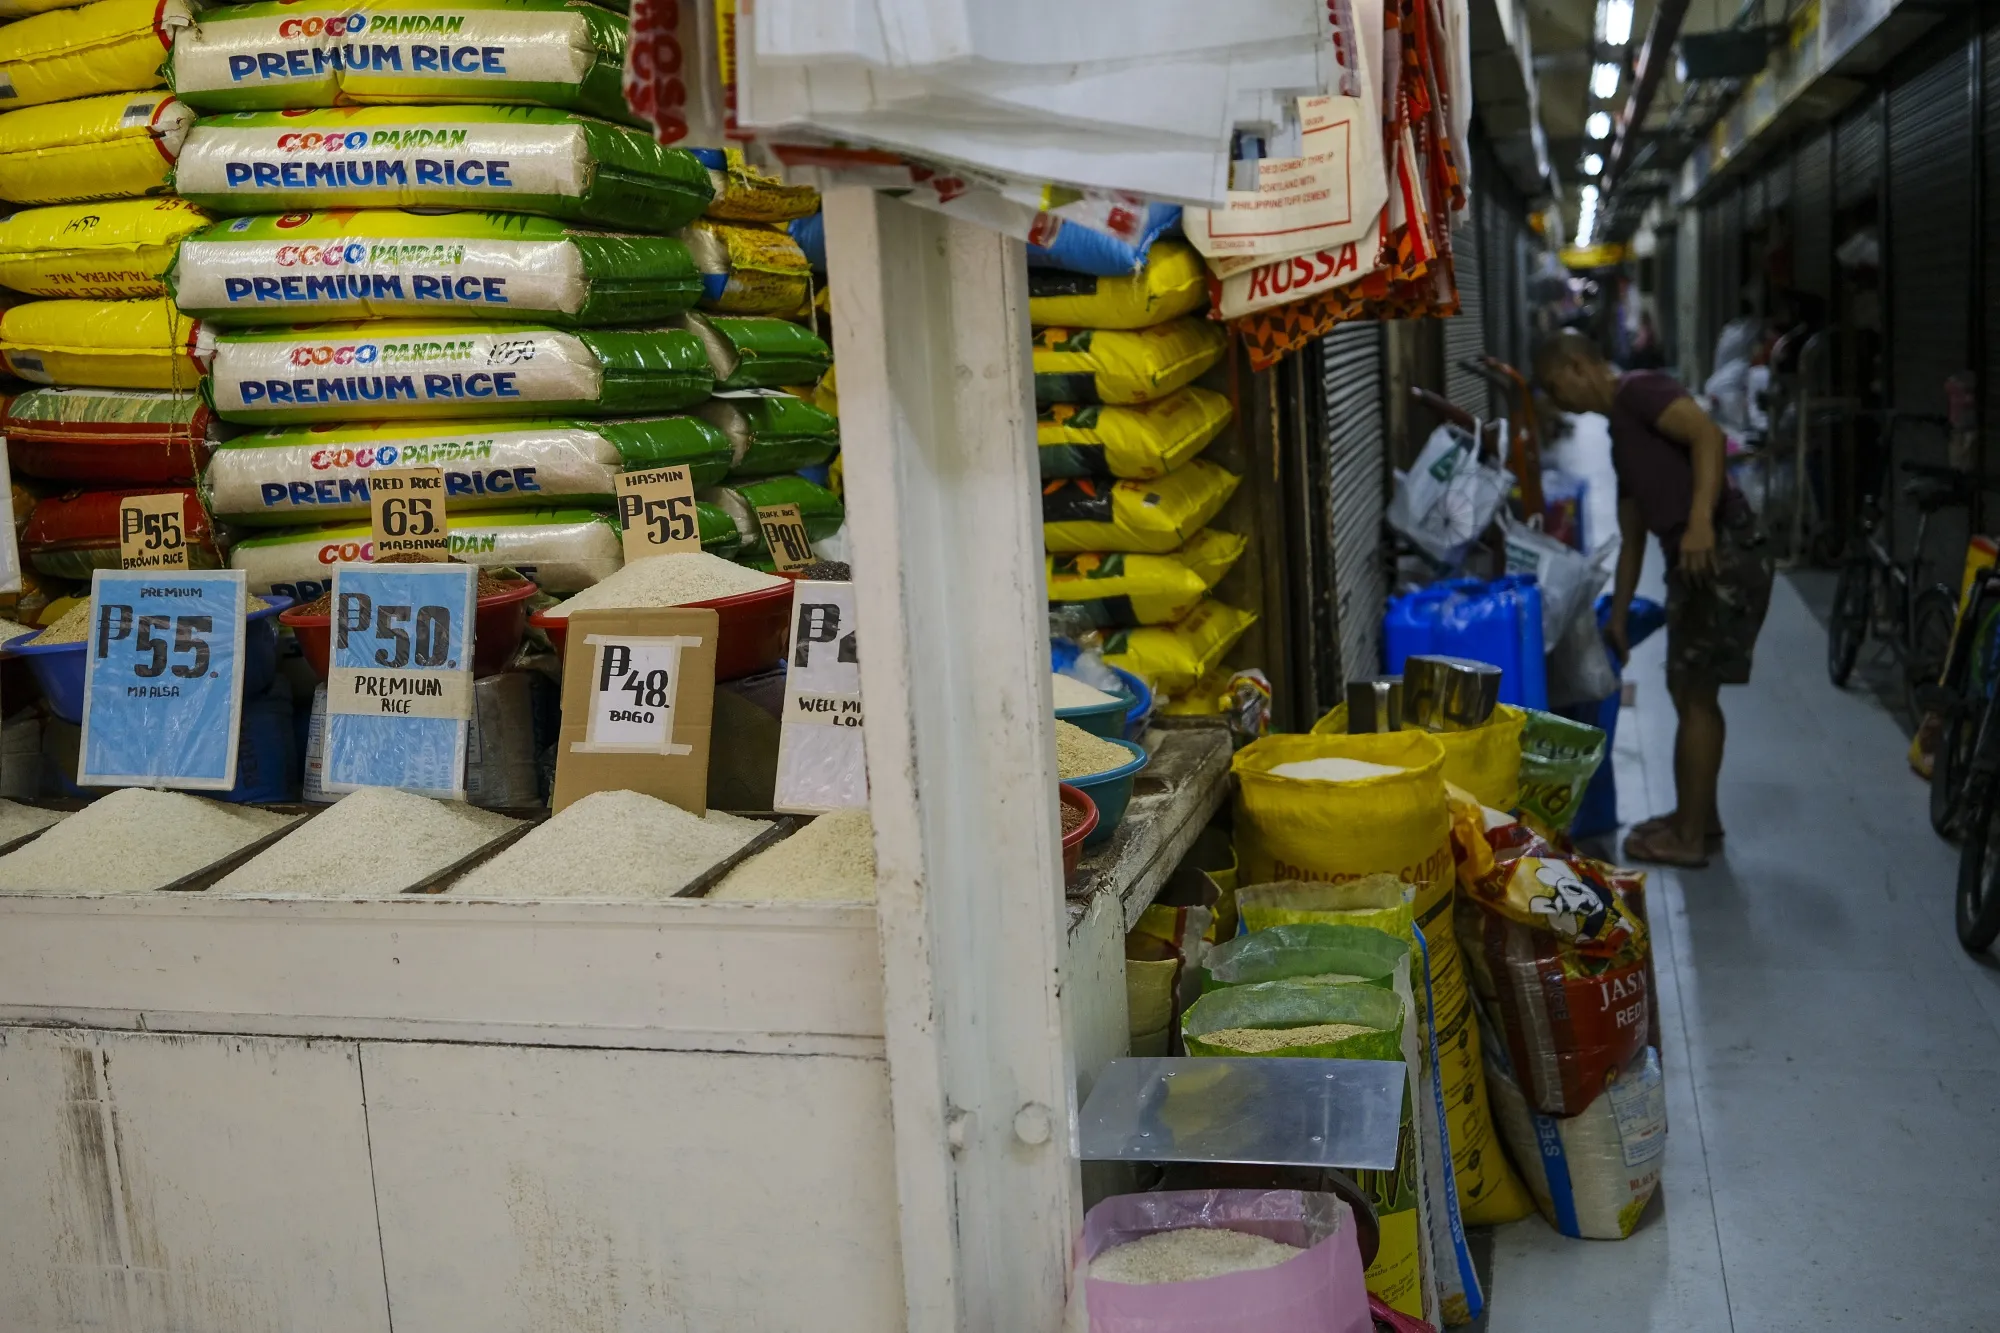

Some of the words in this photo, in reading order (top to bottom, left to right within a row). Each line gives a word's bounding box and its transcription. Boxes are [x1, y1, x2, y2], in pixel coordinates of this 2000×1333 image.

[278, 13, 366, 39] COCO
[369, 15, 465, 36] PANDAN
[411, 46, 507, 75] RICE
[277, 130, 368, 153] COCO
[371, 128, 468, 150] PANDAN
[224, 158, 408, 190] PREMIUM
[416, 158, 513, 188] RICE
[275, 243, 367, 267] COCO
[369, 243, 464, 266] PANDAN
[1247, 241, 1358, 301] ROSSA
[224, 274, 405, 302] PREMIUM
[412, 275, 509, 303] RICE
[290, 345, 378, 366] COCO
[381, 340, 476, 363] PANDAN
[239, 374, 417, 405] PREMIUM
[423, 371, 521, 399] RICE
[310, 446, 399, 471] COCO
[401, 439, 494, 465] PANDAN
[261, 479, 371, 507] PREM
[444, 467, 541, 494] RICE
[372, 477, 406, 492] RED
[409, 475, 443, 491] RICE
[625, 471, 684, 488] HASMIN
[317, 541, 374, 565] COC
[378, 538, 449, 552] MABANGO
[122, 552, 160, 570] BROWN
[162, 551, 184, 565] RICE
[140, 586, 204, 600] PREMIUM
[354, 675, 444, 698] PREMIUM
[380, 697, 413, 715] RICE
[608, 710, 655, 724] BAGO
[799, 697, 837, 715] WELL
[841, 698, 863, 713] MI
[1616, 1001, 1642, 1029] RED
